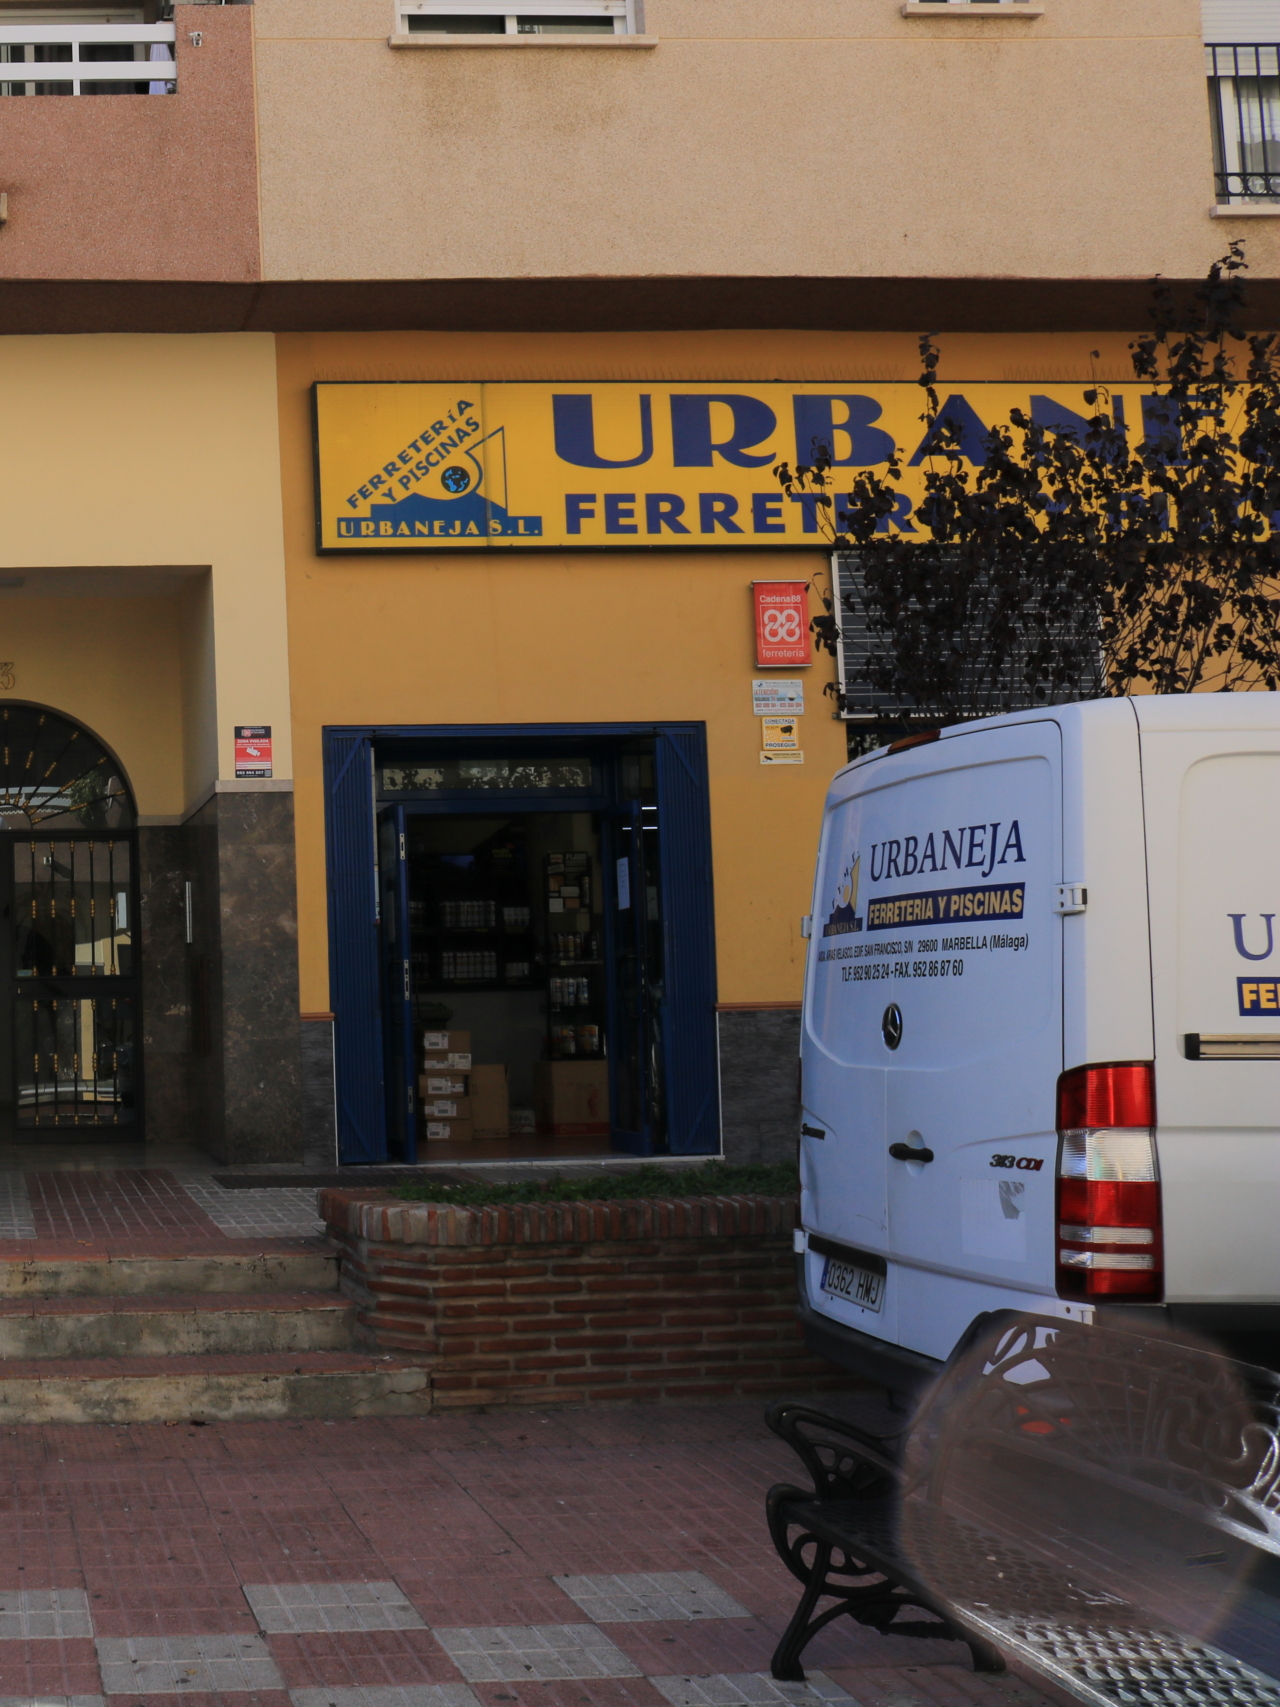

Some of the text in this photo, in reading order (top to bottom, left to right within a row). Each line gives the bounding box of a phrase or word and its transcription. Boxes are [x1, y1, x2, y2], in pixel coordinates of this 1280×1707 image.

[552, 393, 1280, 469] URBANE
[381, 416, 480, 503] Y PISCINAS
[339, 519, 539, 537] URBANEJA S.L.
[763, 648, 804, 658] ferretería
[870, 820, 1026, 882] URBANEJA
[868, 888, 1023, 926] FERRETERIA Y PISCINAS
[864, 944, 873, 957] SAN
[917, 938, 938, 953] 29600
[942, 935, 988, 951] MARBELLA
[989, 933, 1029, 952] (Málaga)
[864, 964, 871, 980] 90
[872, 963, 880, 980] 25
[912, 960, 927, 978] 952
[928, 960, 938, 977] 86
[940, 959, 951, 977] 87
[952, 959, 964, 976] 60
[989, 1153, 1044, 1172] 313 CDI
[827, 1262, 881, 1305] 0362 HMJ
